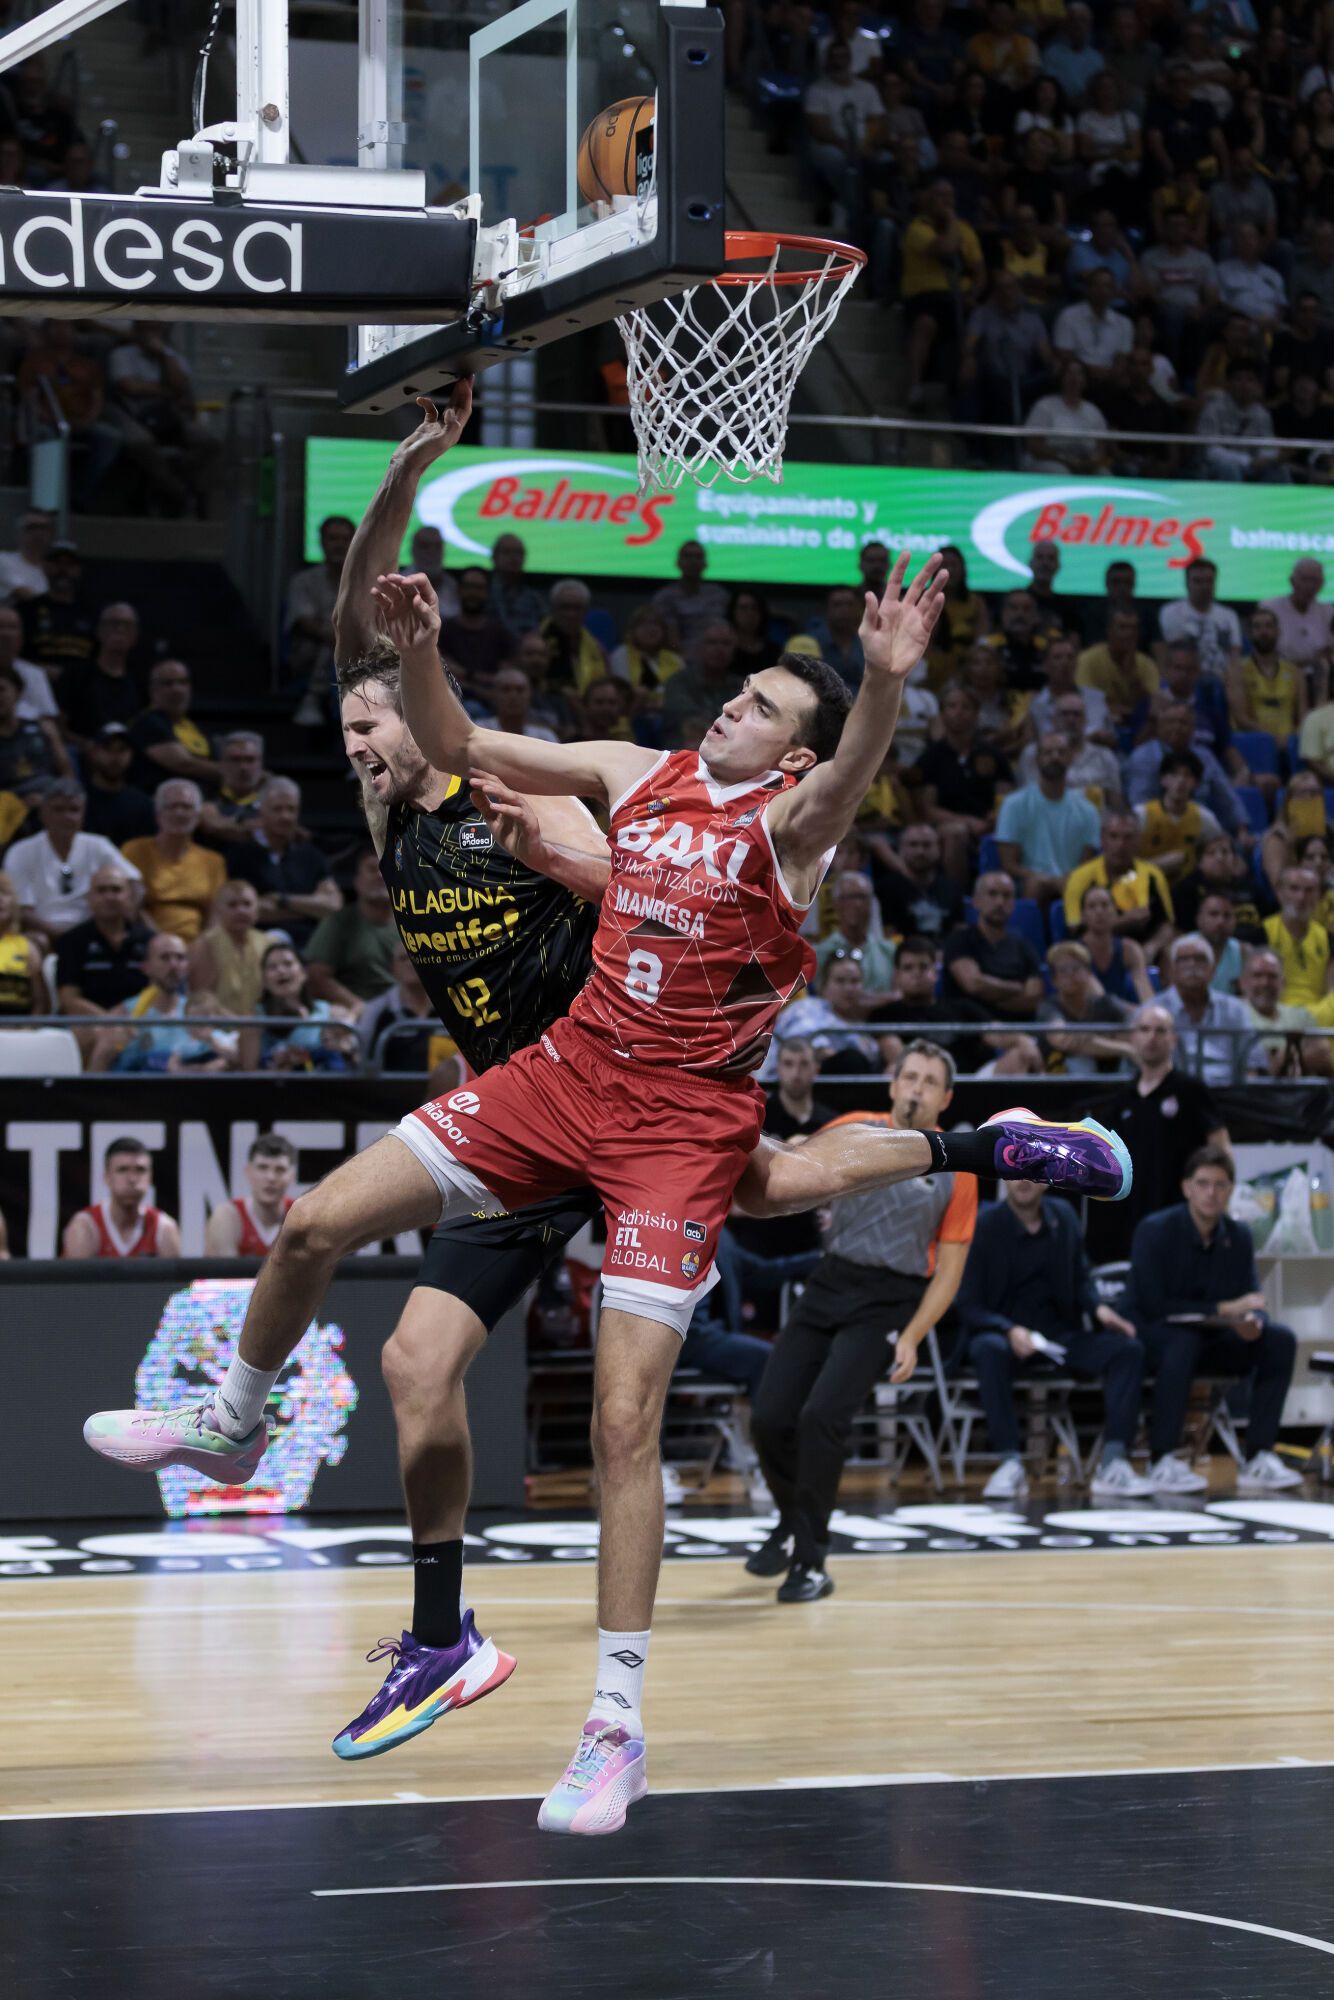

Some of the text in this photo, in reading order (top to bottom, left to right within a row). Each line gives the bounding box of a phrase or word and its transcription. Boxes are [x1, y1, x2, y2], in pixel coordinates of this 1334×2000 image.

[0, 198, 302, 294] desa
[478, 476, 675, 547] Balmes
[697, 489, 878, 524] Equipamiento y
[696, 524, 822, 548] suministro
[826, 526, 856, 549] de
[1029, 502, 1214, 568] Balmes
[461, 831, 475, 841] liga
[462, 837, 490, 847] endesa
[617, 818, 751, 885] BAXI
[391, 885, 516, 915] LA LAGUNA
[614, 884, 705, 940] MANRESA
[624, 948, 663, 1005] 8
[420, 1101, 471, 1146] nilabor
[615, 1227, 642, 1248] ETL
[686, 1228, 701, 1239] acb
[610, 1248, 671, 1274] GLOBAL
